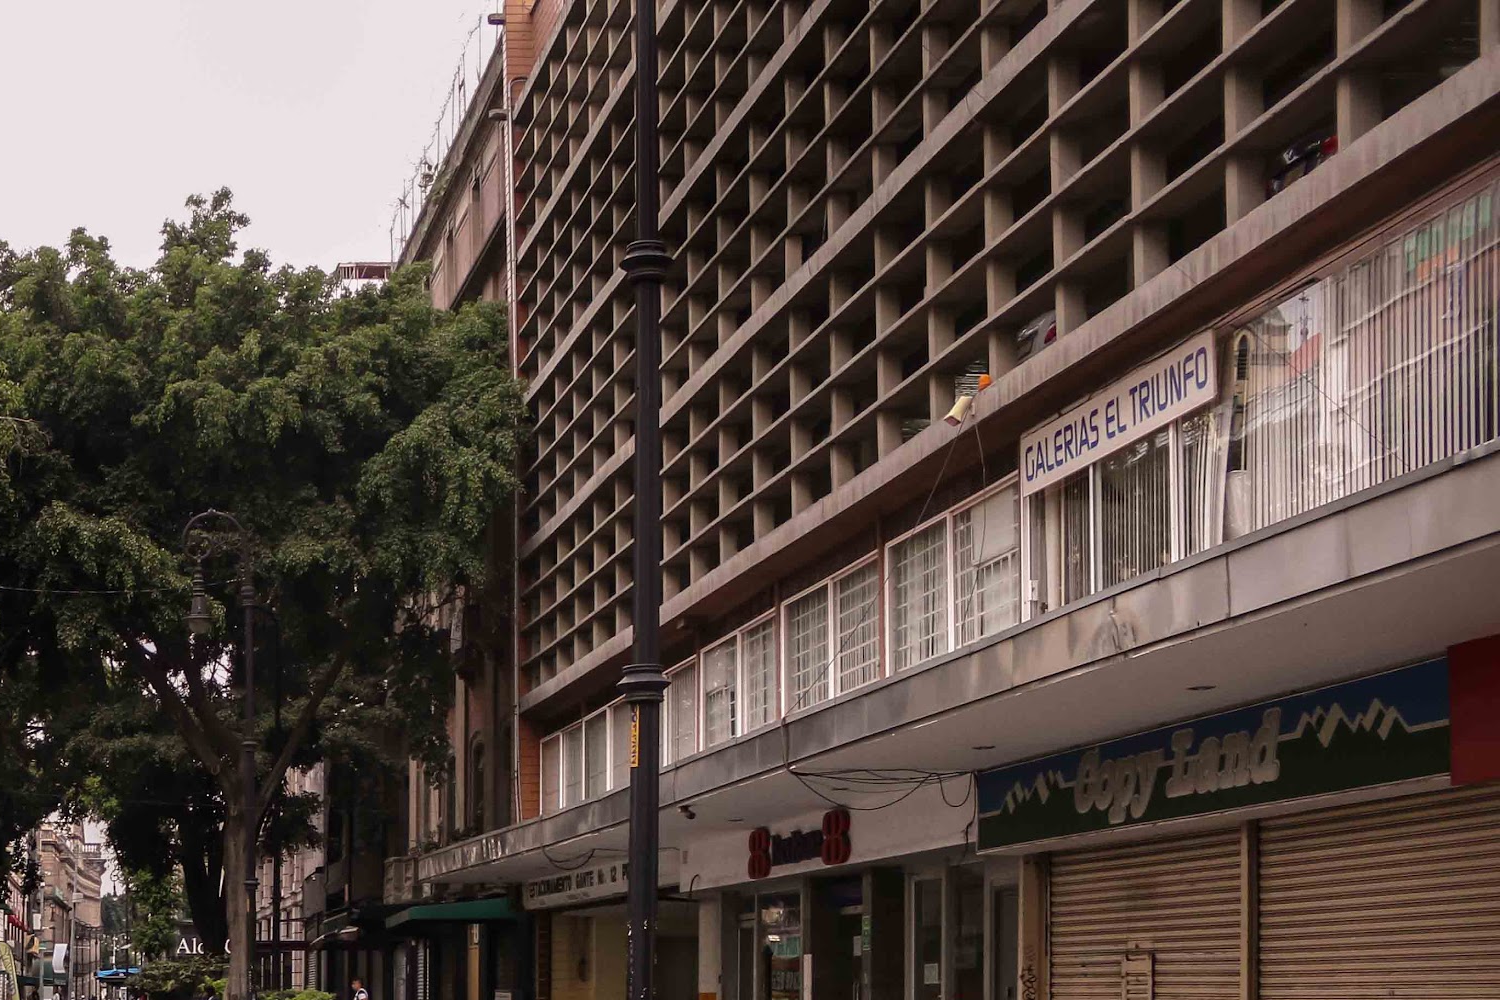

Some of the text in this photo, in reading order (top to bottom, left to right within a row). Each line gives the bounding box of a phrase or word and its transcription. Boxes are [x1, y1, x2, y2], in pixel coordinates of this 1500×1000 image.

[1025, 346, 1209, 482] GALERIAS EL TRIUNFO
[1074, 707, 1281, 824] Copy Land
